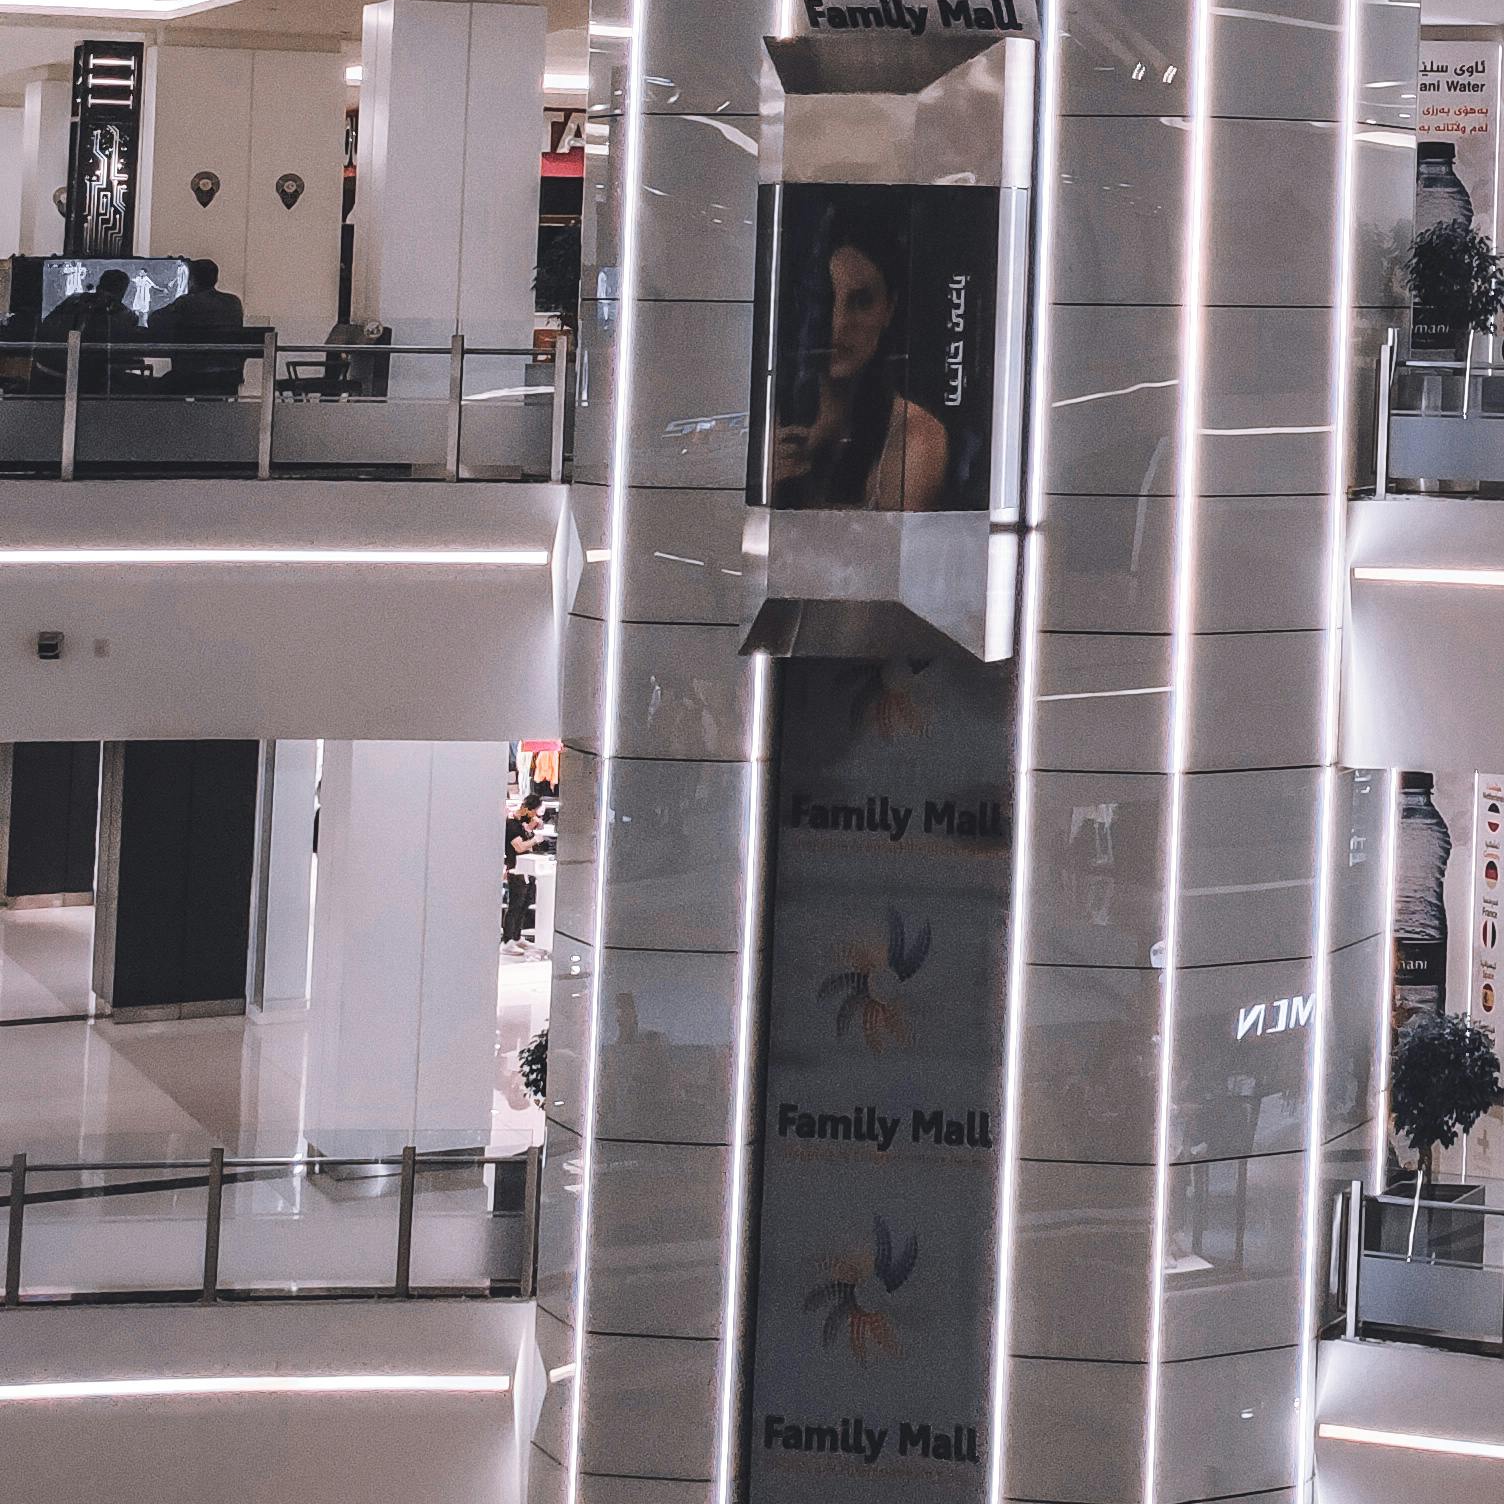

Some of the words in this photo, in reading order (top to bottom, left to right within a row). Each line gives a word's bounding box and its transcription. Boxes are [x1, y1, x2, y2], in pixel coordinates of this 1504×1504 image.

[804, 0, 928, 36] Family
[937, 0, 1023, 30] Mall
[1446, 80, 1486, 92] Water
[791, 794, 912, 842] Family
[924, 800, 1004, 837] Mall
[778, 1103, 900, 1152] Family
[911, 1109, 992, 1149] Mall
[764, 1414, 887, 1464] Family
[898, 1421, 979, 1463] Mall
